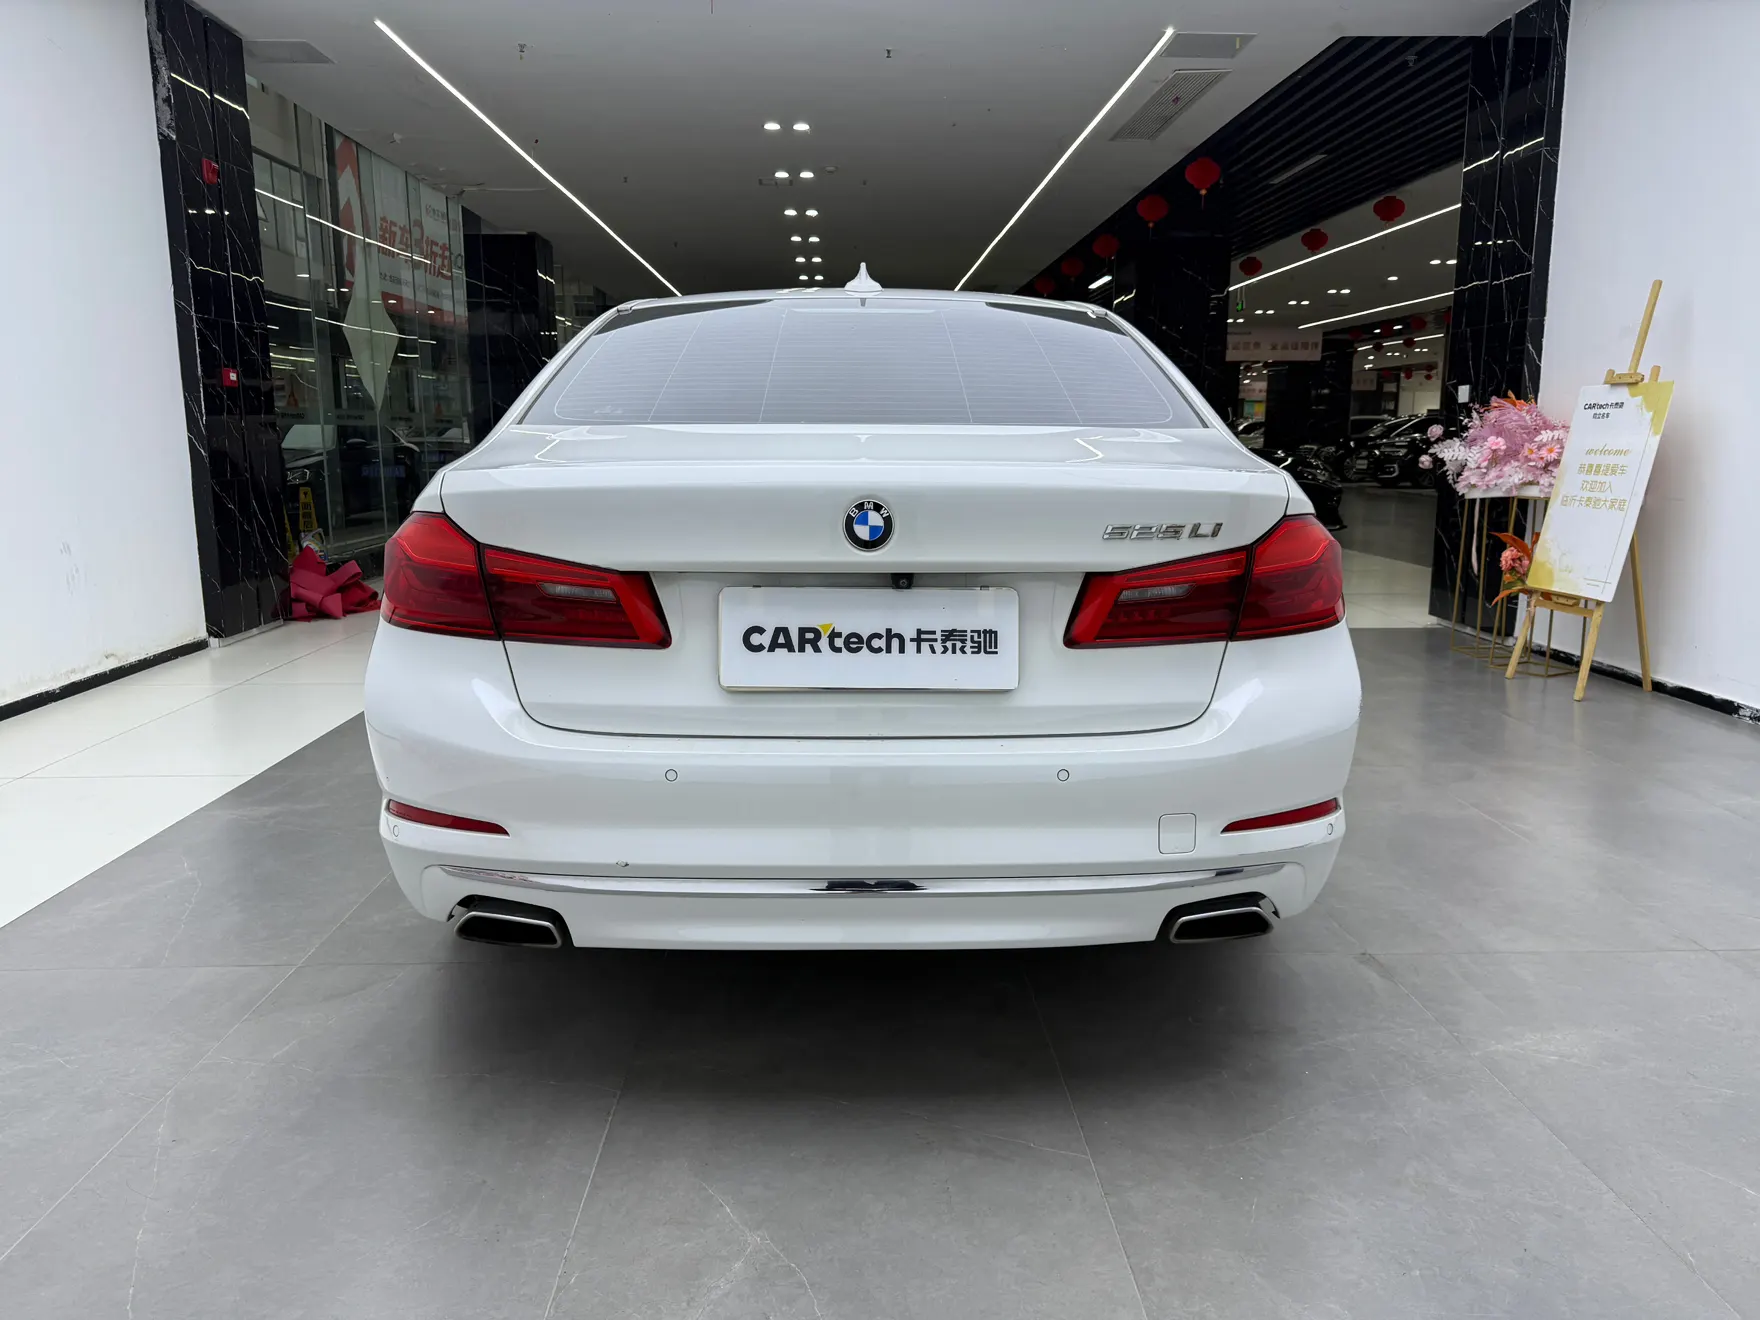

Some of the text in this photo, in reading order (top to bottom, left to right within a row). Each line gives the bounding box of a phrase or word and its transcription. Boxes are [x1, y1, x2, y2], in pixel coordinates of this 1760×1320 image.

[1585, 444, 1630, 456] welcome
[1580, 480, 1612, 493] 欢迎加入
[849, 499, 889, 518] BMW
